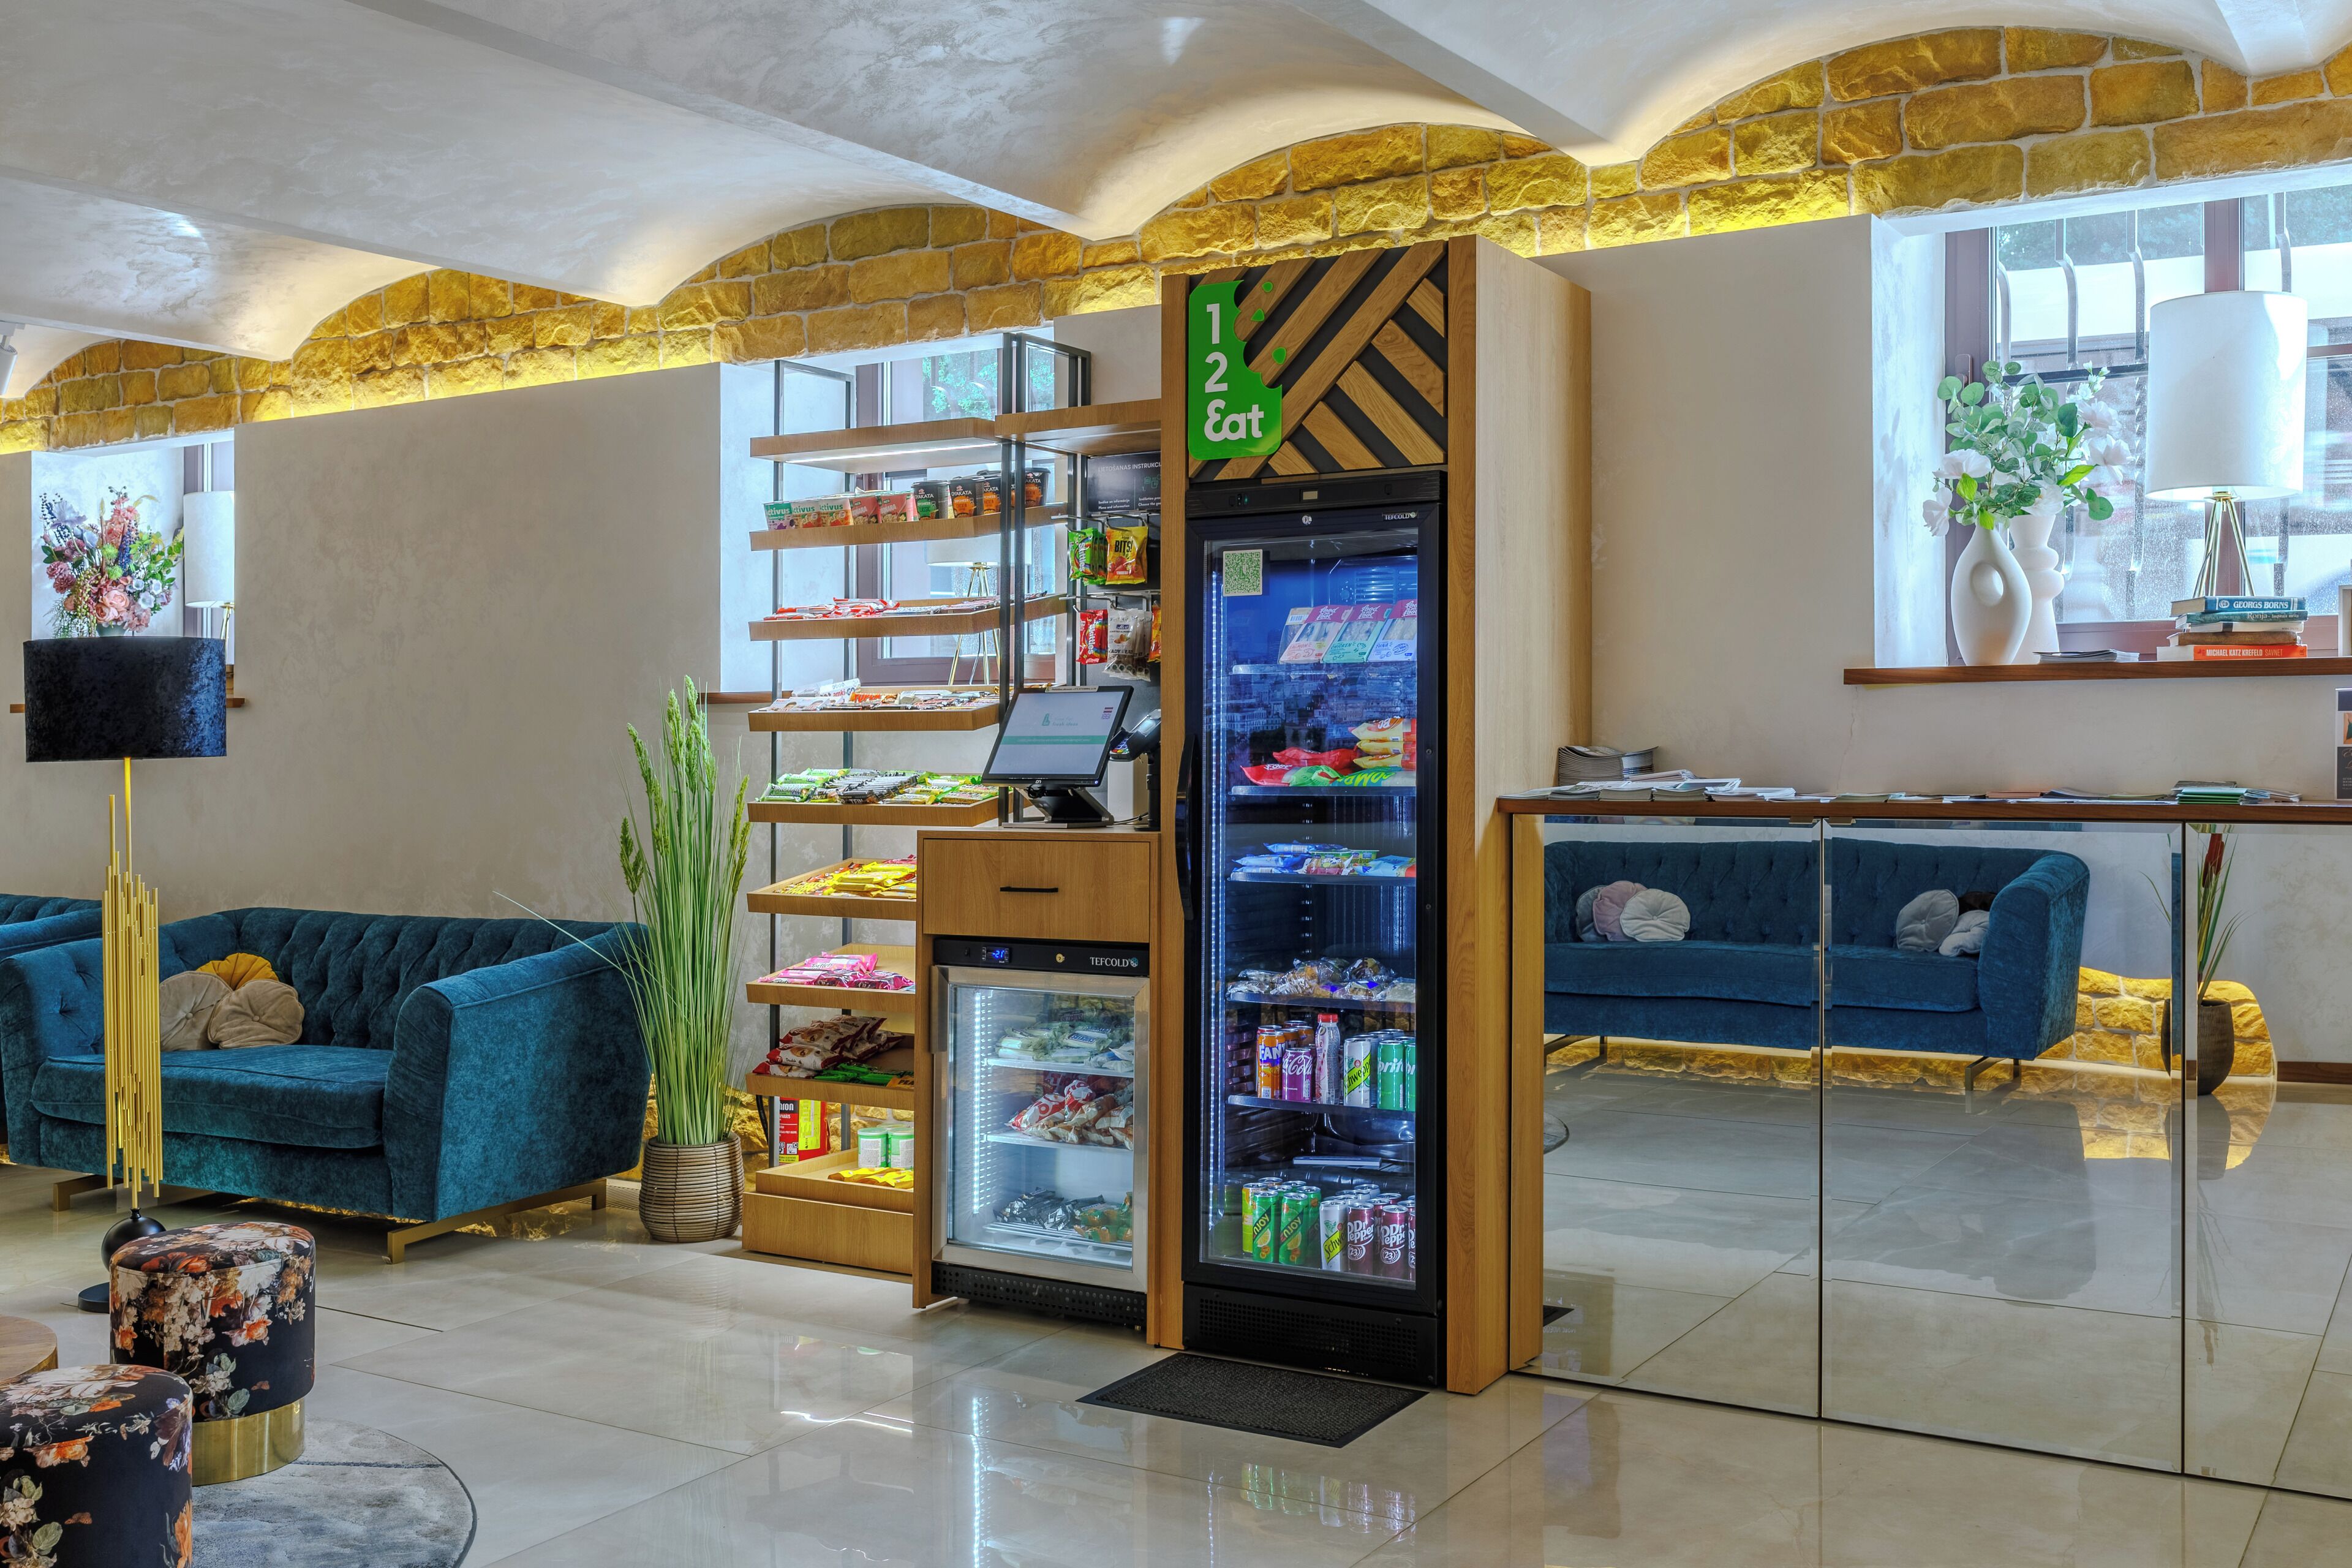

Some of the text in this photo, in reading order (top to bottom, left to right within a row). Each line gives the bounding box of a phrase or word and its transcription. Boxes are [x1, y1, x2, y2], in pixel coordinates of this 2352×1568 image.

[1206, 303, 1220, 344] 1
[1204, 352, 1228, 393] 2
[1204, 399, 1264, 442] Eat
[1115, 540, 1133, 552] BITS!
[1090, 957, 1129, 967] TEFCOLD
[1384, 1251, 1393, 1260] 23
